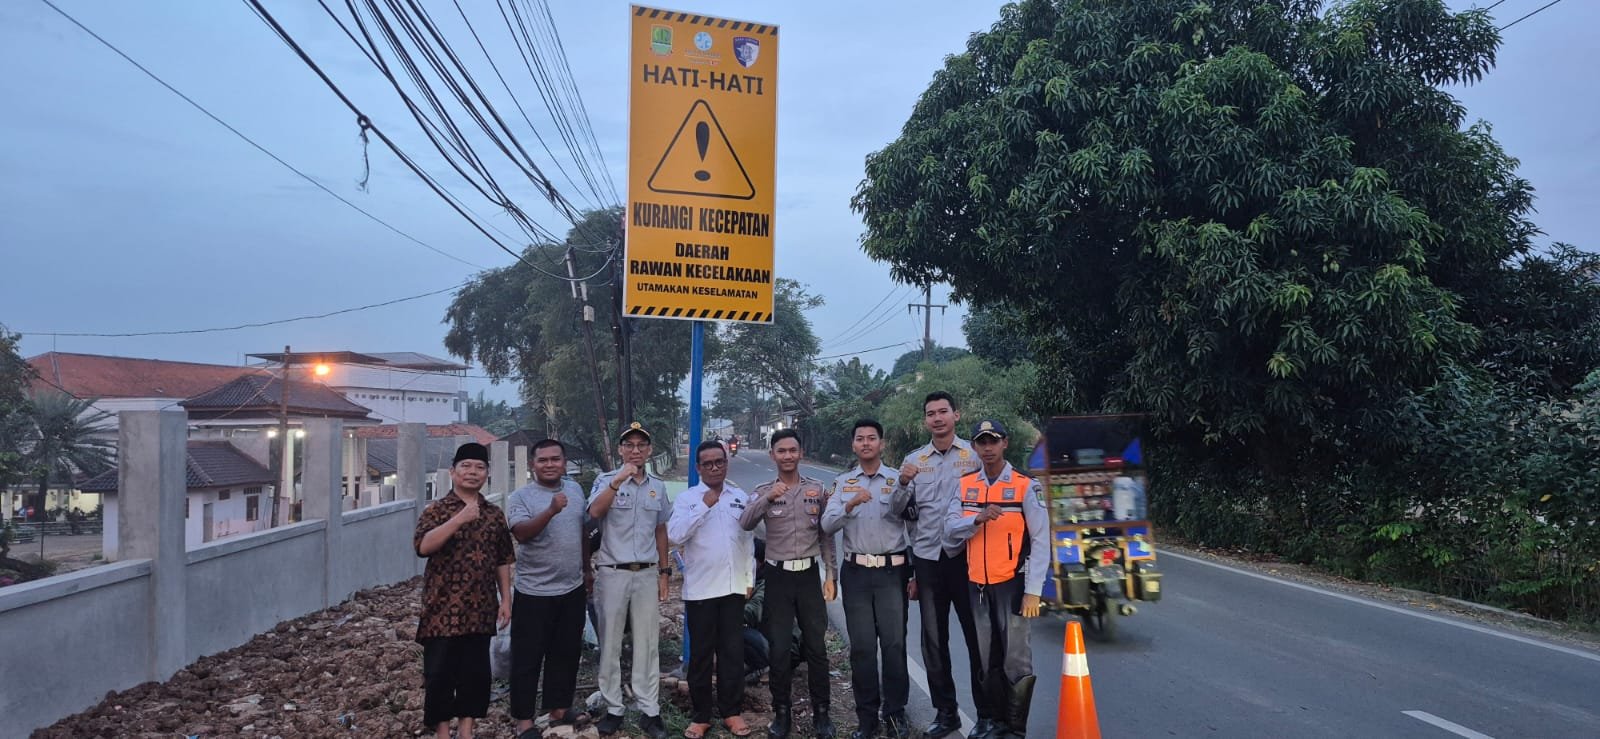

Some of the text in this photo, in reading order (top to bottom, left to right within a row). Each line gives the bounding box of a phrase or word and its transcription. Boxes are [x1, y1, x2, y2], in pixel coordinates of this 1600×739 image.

[643, 63, 763, 95] HATI-HATI
[633, 202, 770, 237] KURANGI KECEPATAN
[675, 242, 729, 260] DAERAH
[630, 260, 770, 284] RAWAN KECELAKAAN
[637, 282, 758, 299] UTAMAKAN KESELAMATAN
